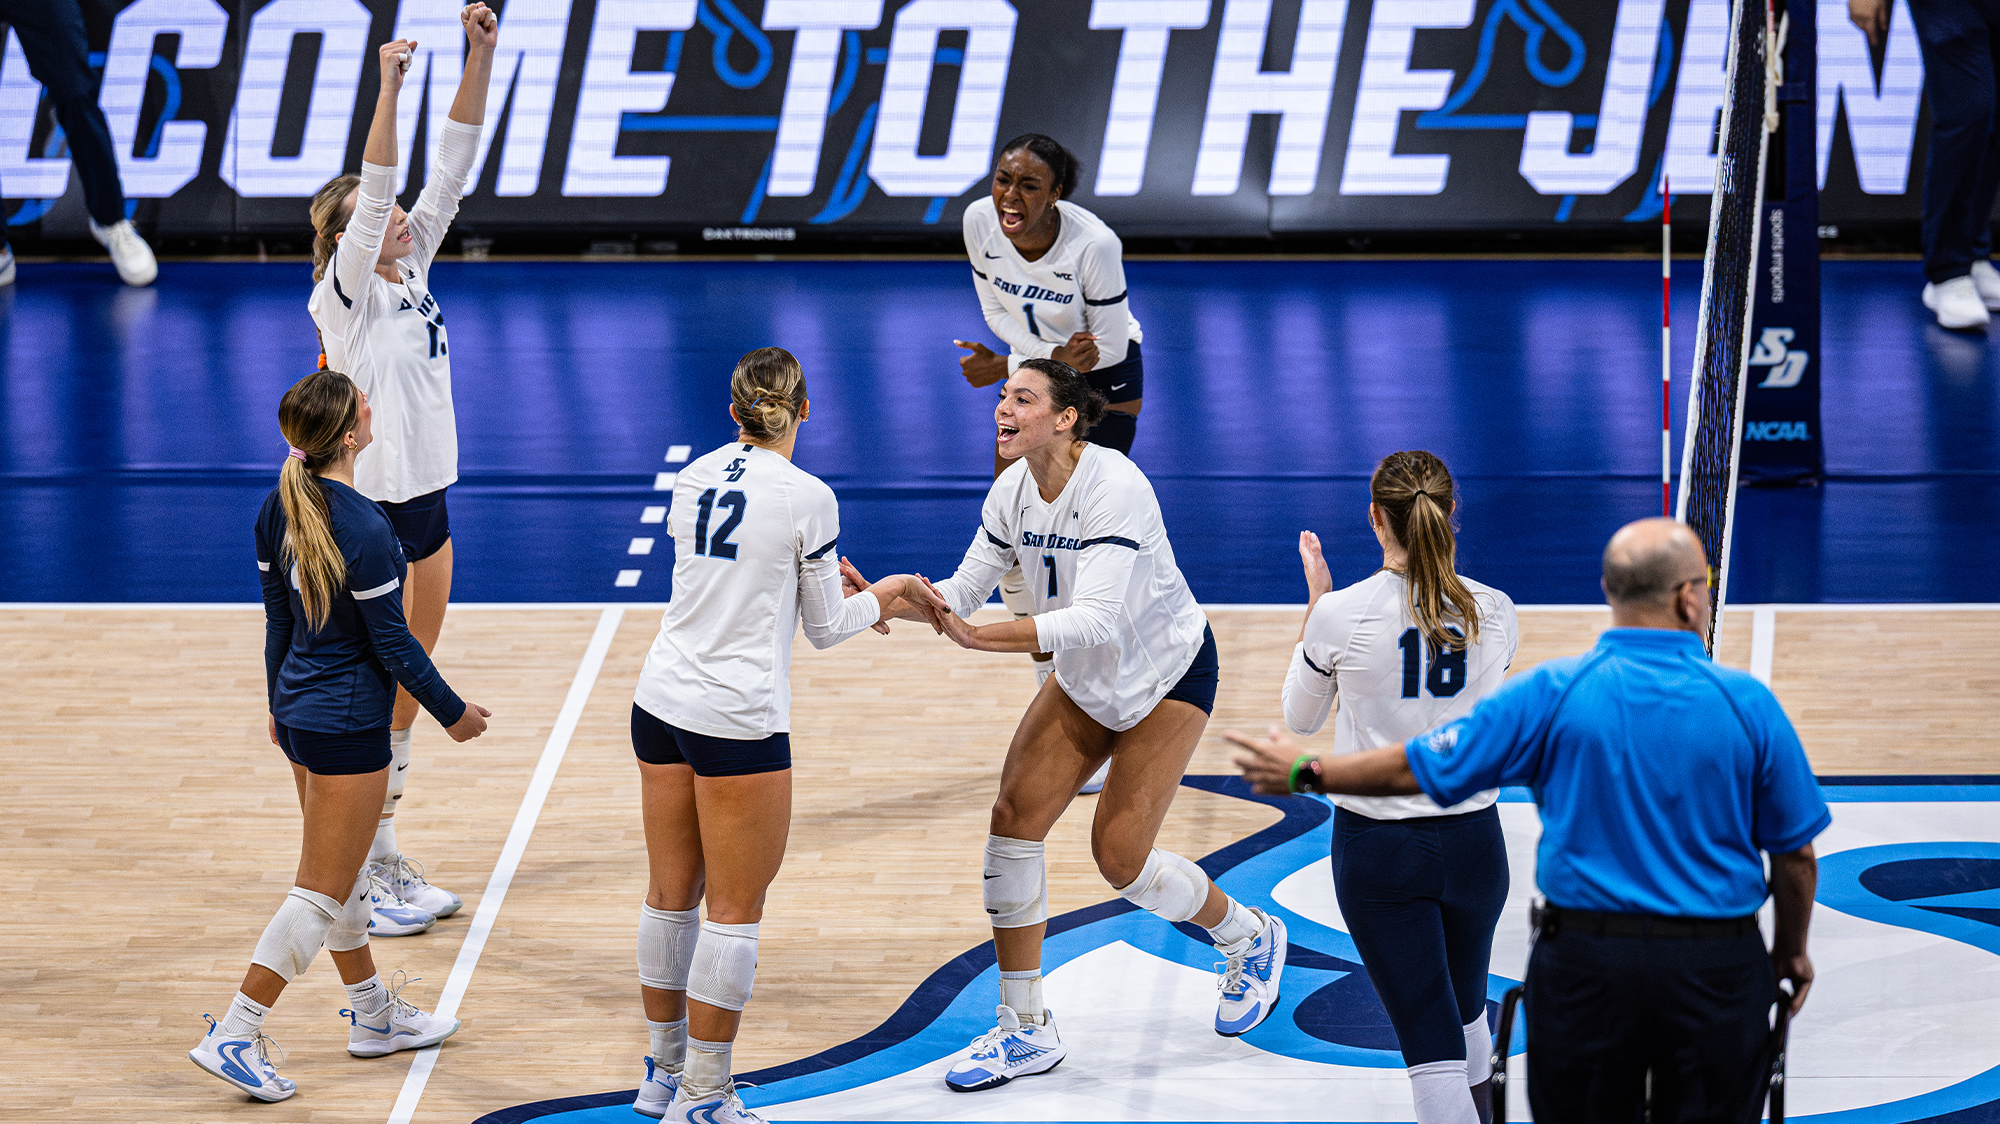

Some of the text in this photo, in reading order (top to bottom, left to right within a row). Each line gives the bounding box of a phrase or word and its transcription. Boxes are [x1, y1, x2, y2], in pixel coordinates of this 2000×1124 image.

[762, 0, 1019, 198] TO
[1088, 0, 1476, 197] THE
[1053, 271, 1073, 281] WCC
[1021, 284, 1075, 305] DIEGO
[1022, 302, 1041, 338] 1
[1749, 327, 1810, 389] SD
[1744, 421, 1808, 441] NCAA
[722, 458, 747, 483] SD
[694, 487, 748, 562] 12
[1022, 531, 1081, 551] SAN DEGO
[1398, 626, 1468, 700] 18
